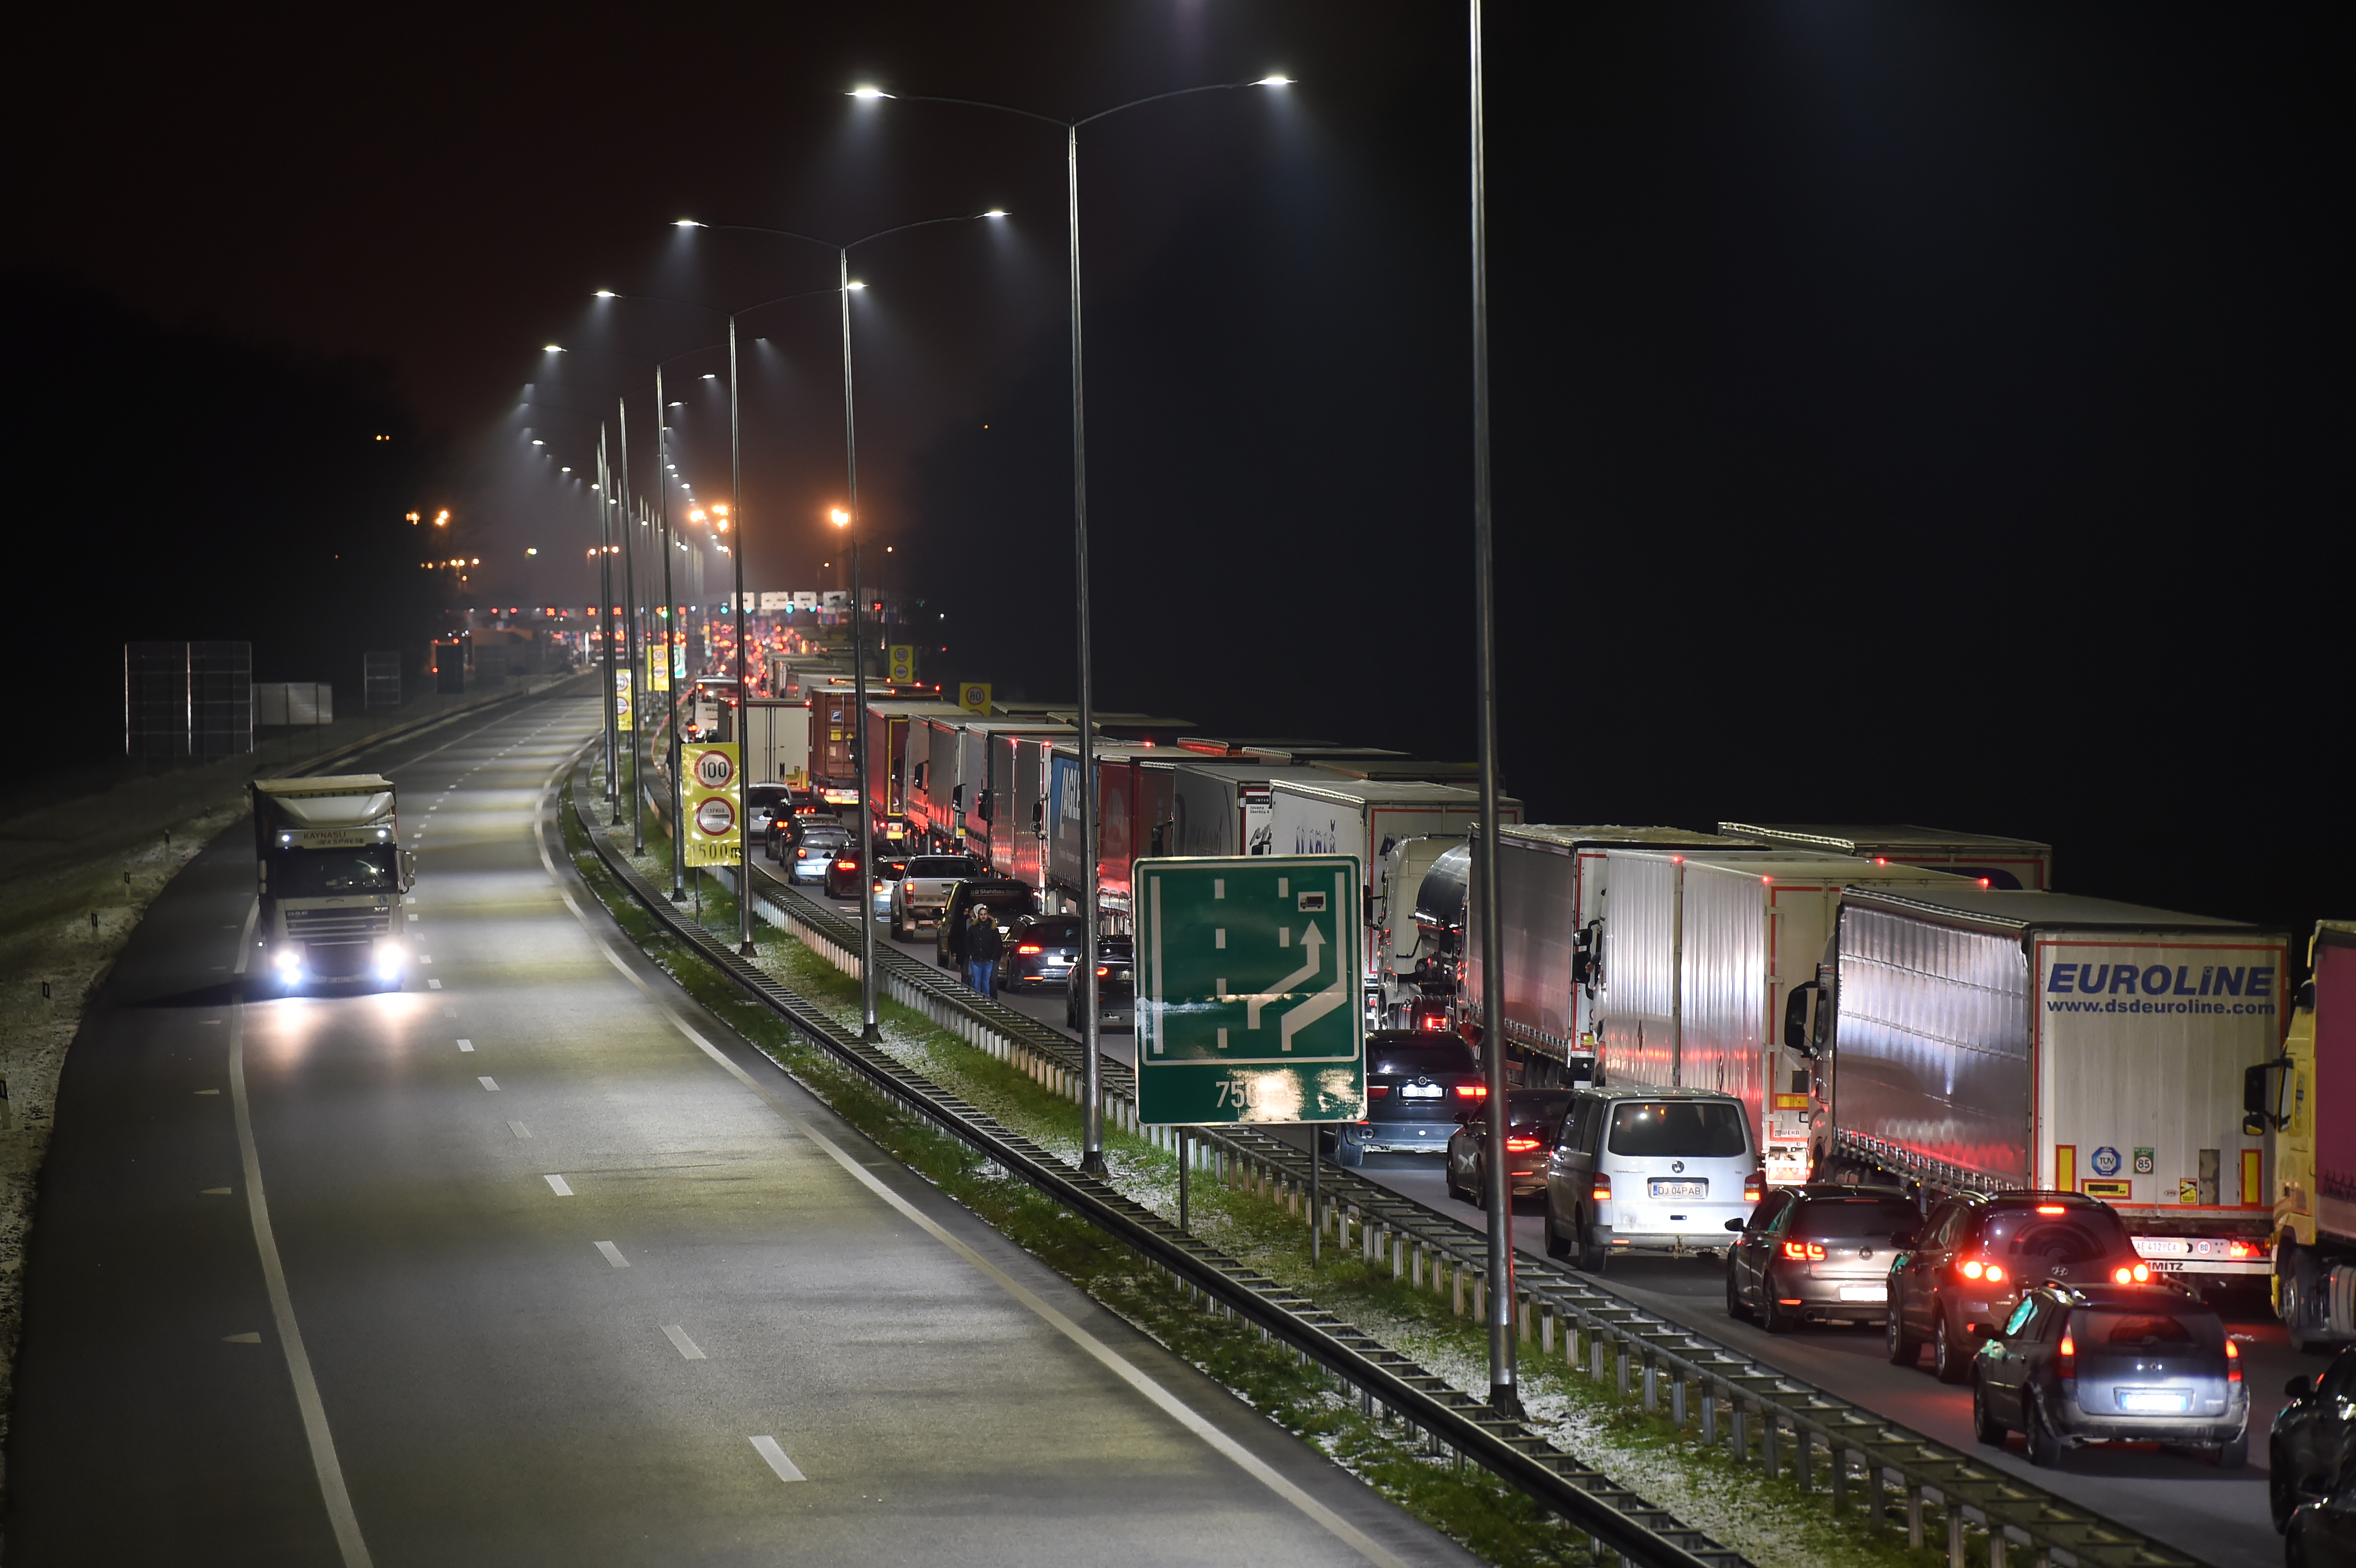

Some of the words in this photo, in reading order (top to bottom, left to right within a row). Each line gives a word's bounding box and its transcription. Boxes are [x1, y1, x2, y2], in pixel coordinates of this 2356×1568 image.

[970, 691, 981, 701] 80
[702, 762, 727, 778] 100
[2048, 963, 2275, 996] EUROLINE
[2047, 999, 2275, 1015] www.dsdeuroline.com
[2138, 1159, 2150, 1168] 85
[1658, 1186, 1669, 1195] DJ
[2148, 1243, 2161, 1251] 412
[2168, 1243, 2177, 1251] CA
